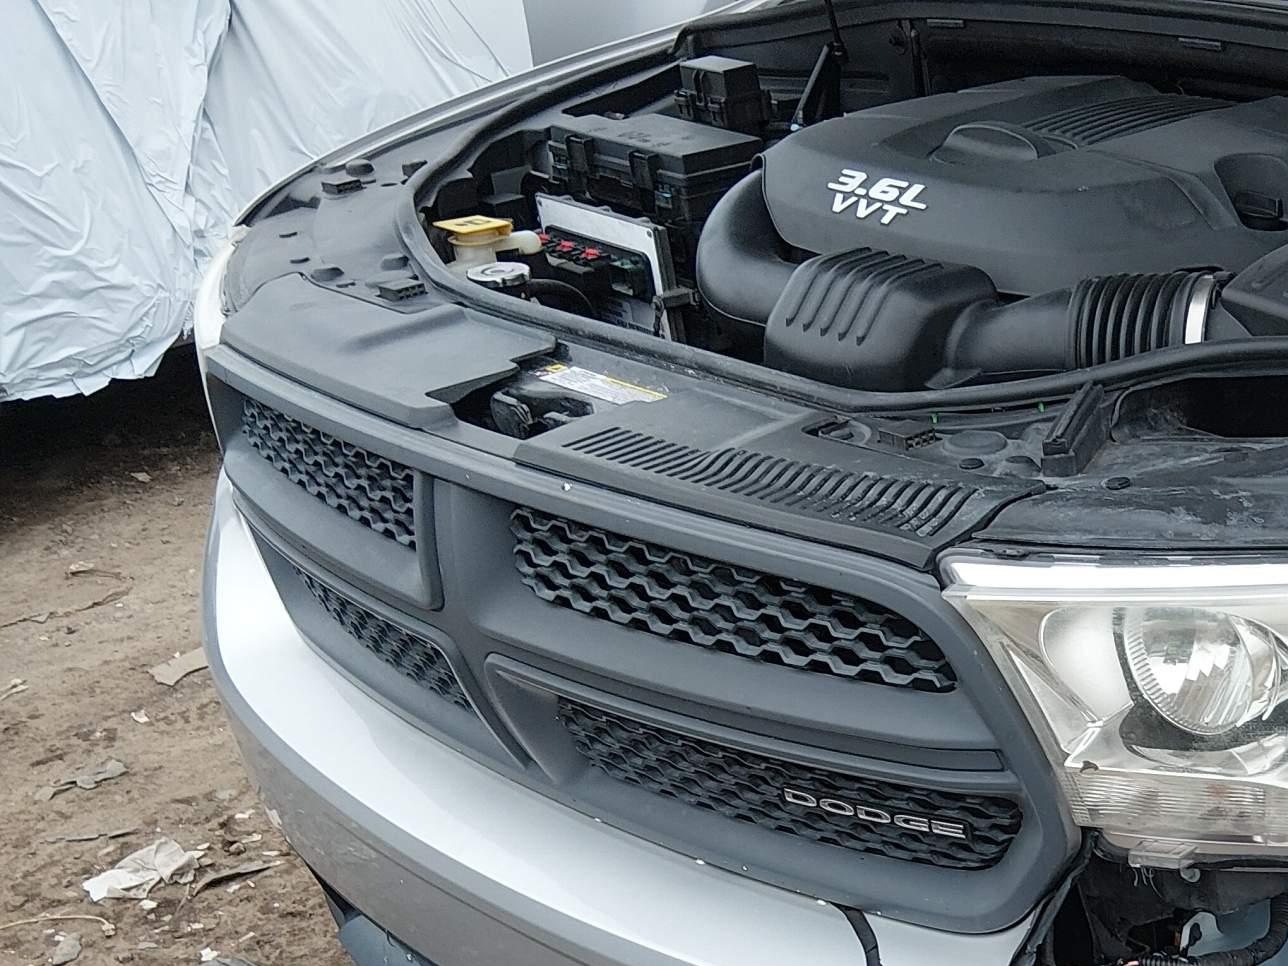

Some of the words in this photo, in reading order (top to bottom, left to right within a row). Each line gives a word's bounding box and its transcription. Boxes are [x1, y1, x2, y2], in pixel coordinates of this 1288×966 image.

[827, 168, 928, 210] 3.6L
[831, 192, 909, 225] VVT
[783, 786, 967, 839] DODGE
